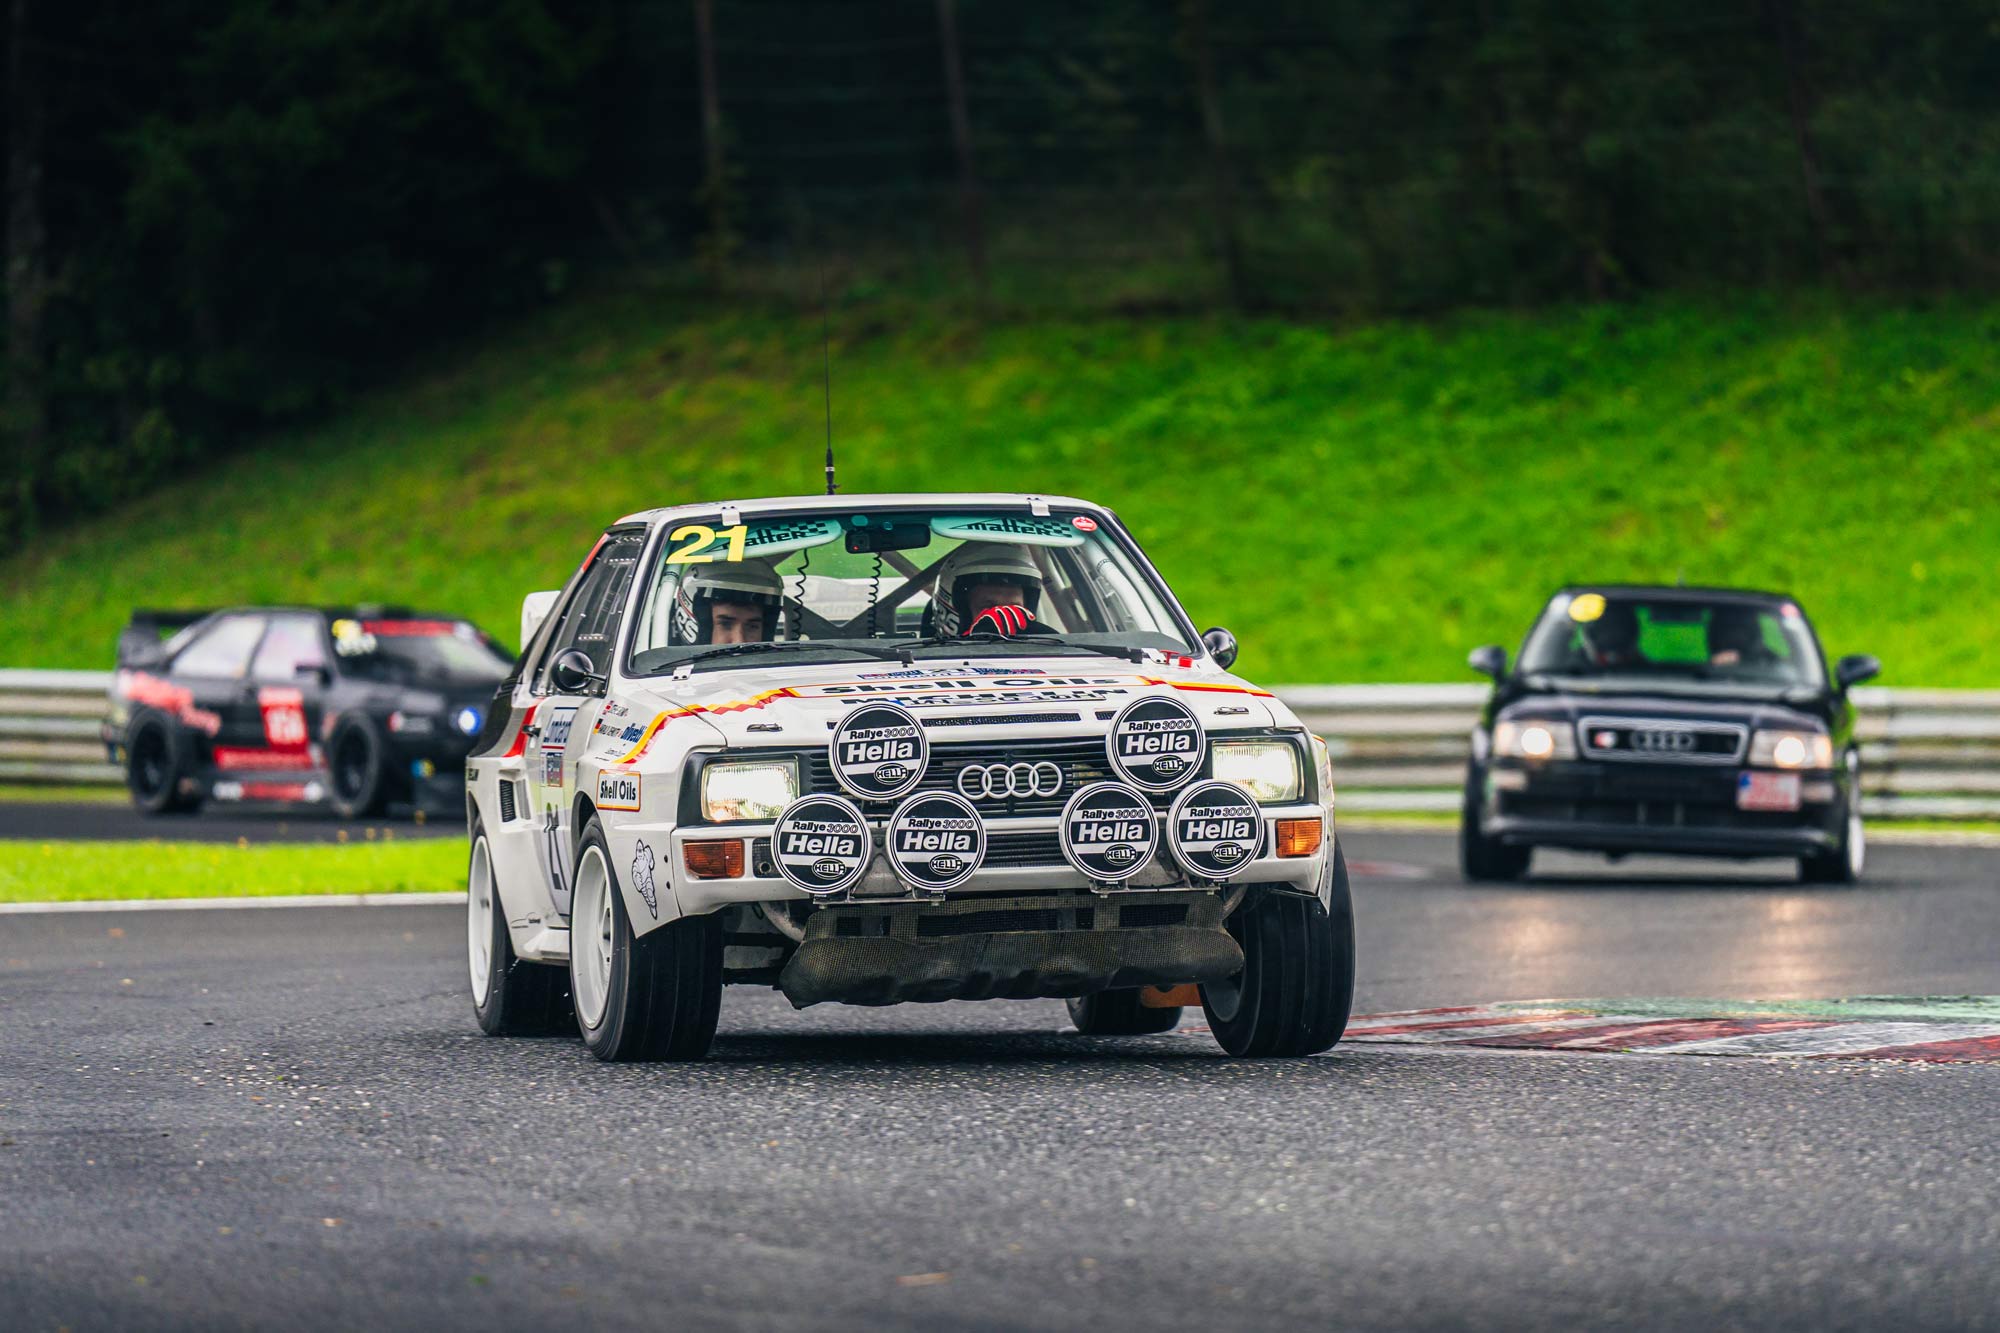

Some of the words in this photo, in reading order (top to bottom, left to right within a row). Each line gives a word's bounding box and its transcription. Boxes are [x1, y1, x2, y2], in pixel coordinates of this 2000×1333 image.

[666, 525, 748, 564] 21
[822, 680, 976, 694] Shell
[993, 678, 1120, 687] Oils
[850, 729, 883, 740] Rallye
[884, 726, 916, 738] 3000
[1129, 721, 1161, 732] Rallye
[1162, 719, 1193, 730] 3000
[846, 740, 914, 763] Hella
[1125, 732, 1191, 754] Hella
[600, 779, 618, 800] Shell
[619, 780, 637, 801] Oils
[1081, 809, 1115, 820] Rallye
[1115, 809, 1146, 819] 3000
[1190, 808, 1222, 817] Rallye
[1222, 807, 1252, 817] 3000
[792, 821, 826, 832] Rallye
[827, 823, 859, 833] 3000
[908, 818, 942, 829] Rallye
[942, 819, 975, 829] 3000
[1078, 822, 1144, 842] Hella
[1186, 819, 1250, 840] Hella
[786, 834, 855, 855] Hella
[903, 831, 971, 850] Hella
